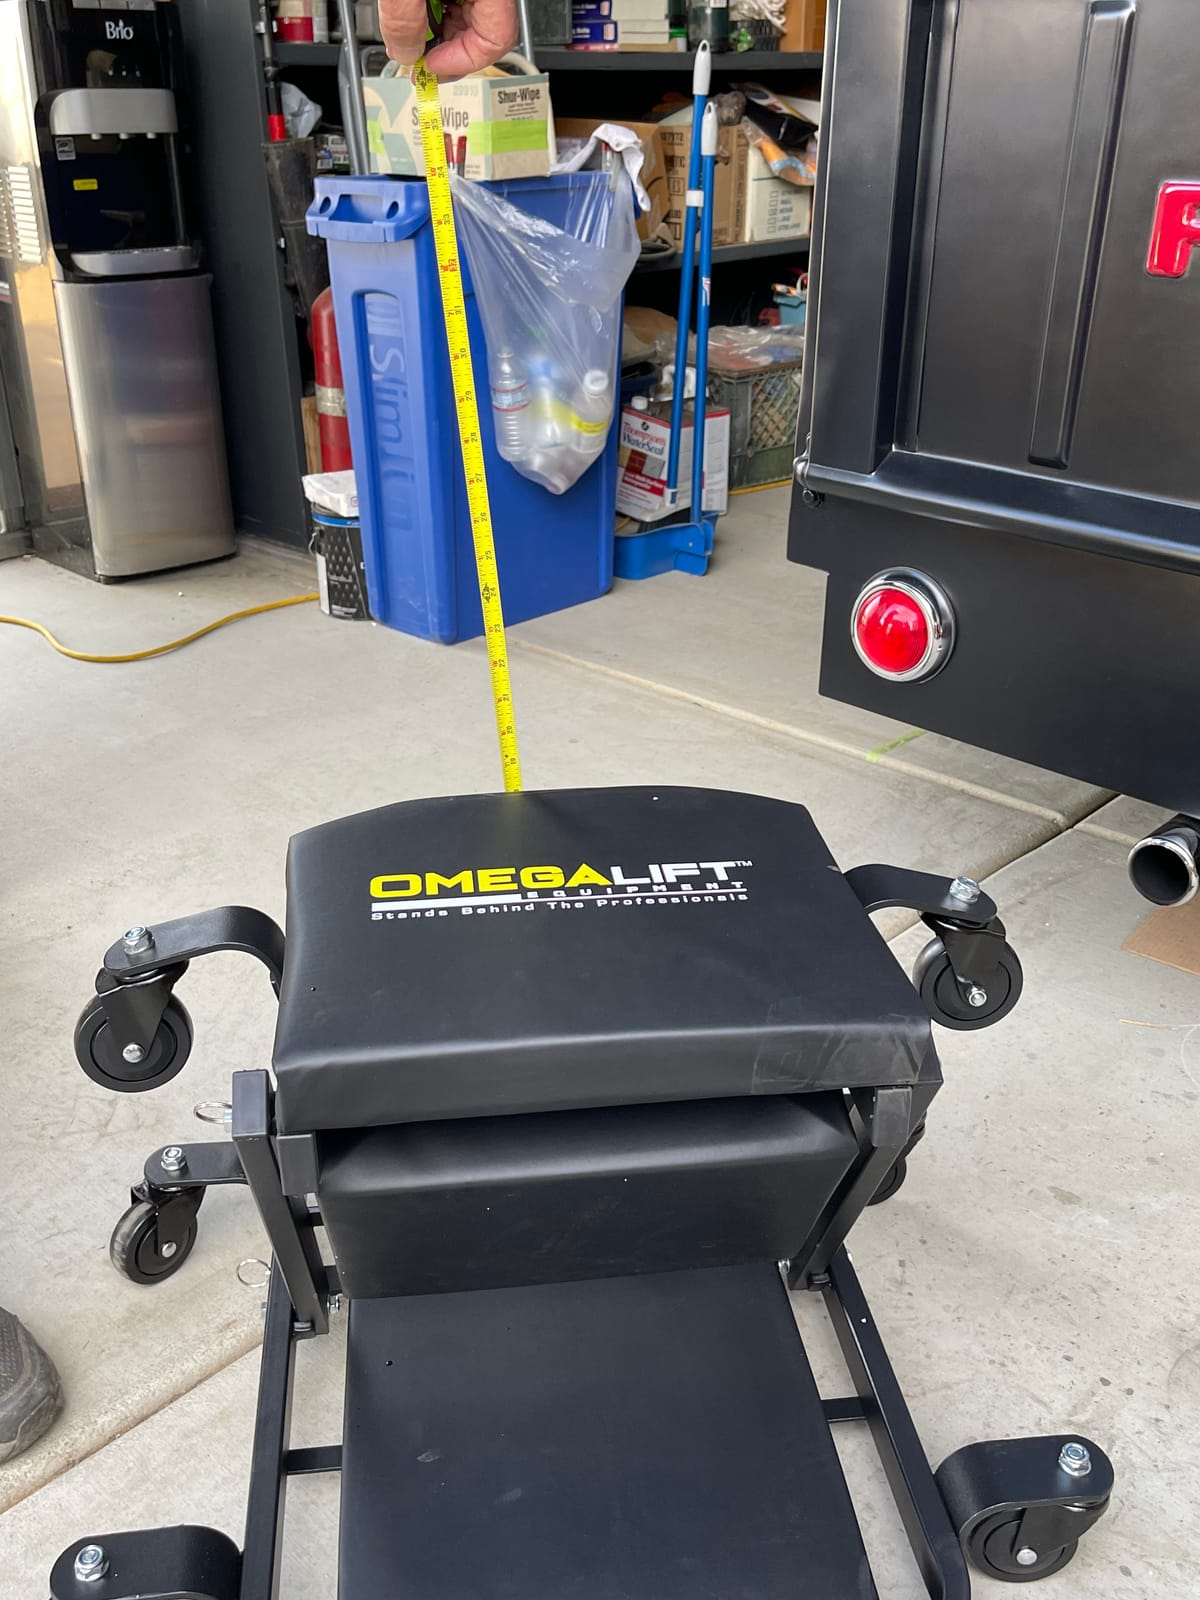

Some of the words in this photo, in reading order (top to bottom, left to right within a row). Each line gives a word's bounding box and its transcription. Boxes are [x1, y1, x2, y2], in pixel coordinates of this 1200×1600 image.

[105, 19, 134, 40] Brio
[497, 87, 541, 105] Shur-Wipe
[411, 106, 469, 131] SWipe
[431, 118, 439, 131] 35
[437, 166, 445, 179] 34
[443, 213, 451, 226] 33
[454, 305, 462, 315] 31
[460, 347, 468, 359] 30
[370, 344, 408, 444] Slim
[465, 390, 473, 401] 29
[476, 473, 483, 483] 27
[485, 550, 492, 560] 25
[526, 881, 744, 899] EQUIPMENT
[371, 909, 449, 921] Stands
[461, 902, 535, 915] Behind
[547, 901, 585, 910] The
[597, 893, 749, 908] Professionals
